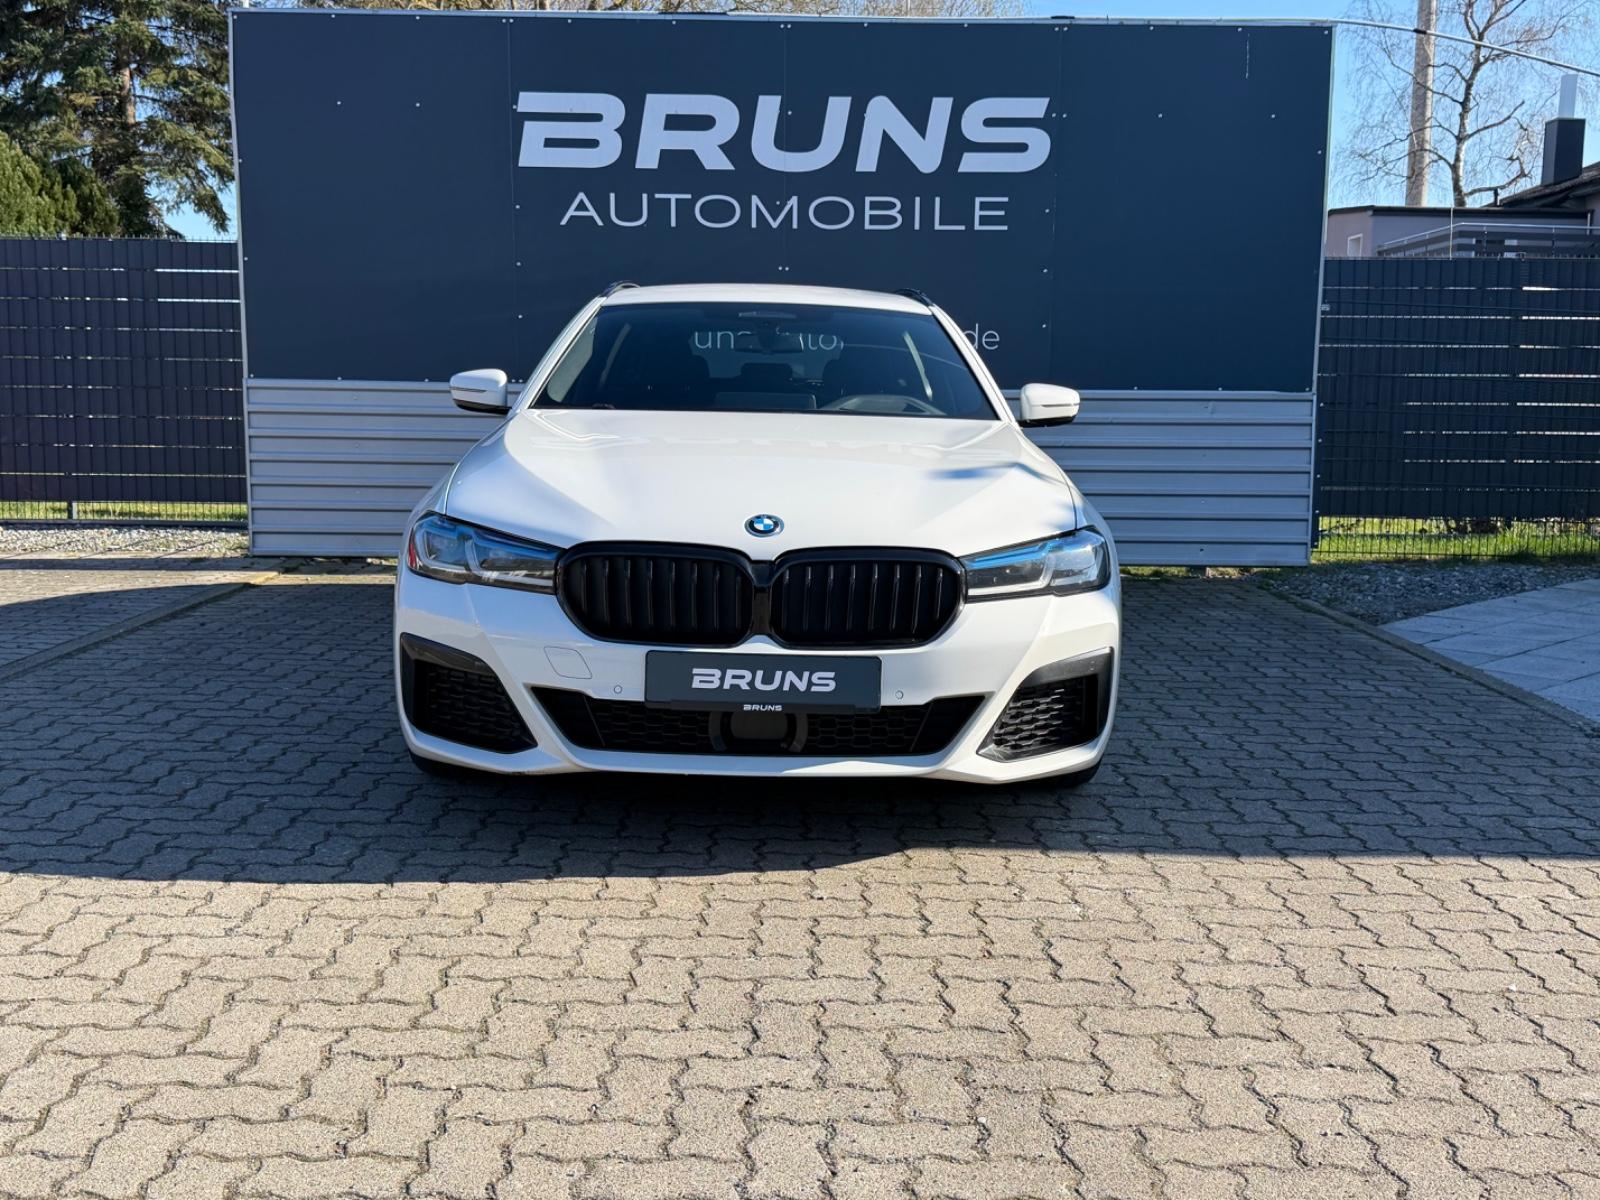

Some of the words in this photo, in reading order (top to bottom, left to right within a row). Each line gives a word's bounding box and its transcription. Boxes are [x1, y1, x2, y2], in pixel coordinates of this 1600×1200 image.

[512, 91, 1051, 174] BRUNS
[559, 191, 1009, 231] AUTOMOBILE
[691, 667, 837, 693] BRUNS
[743, 703, 783, 712] BRUNS
